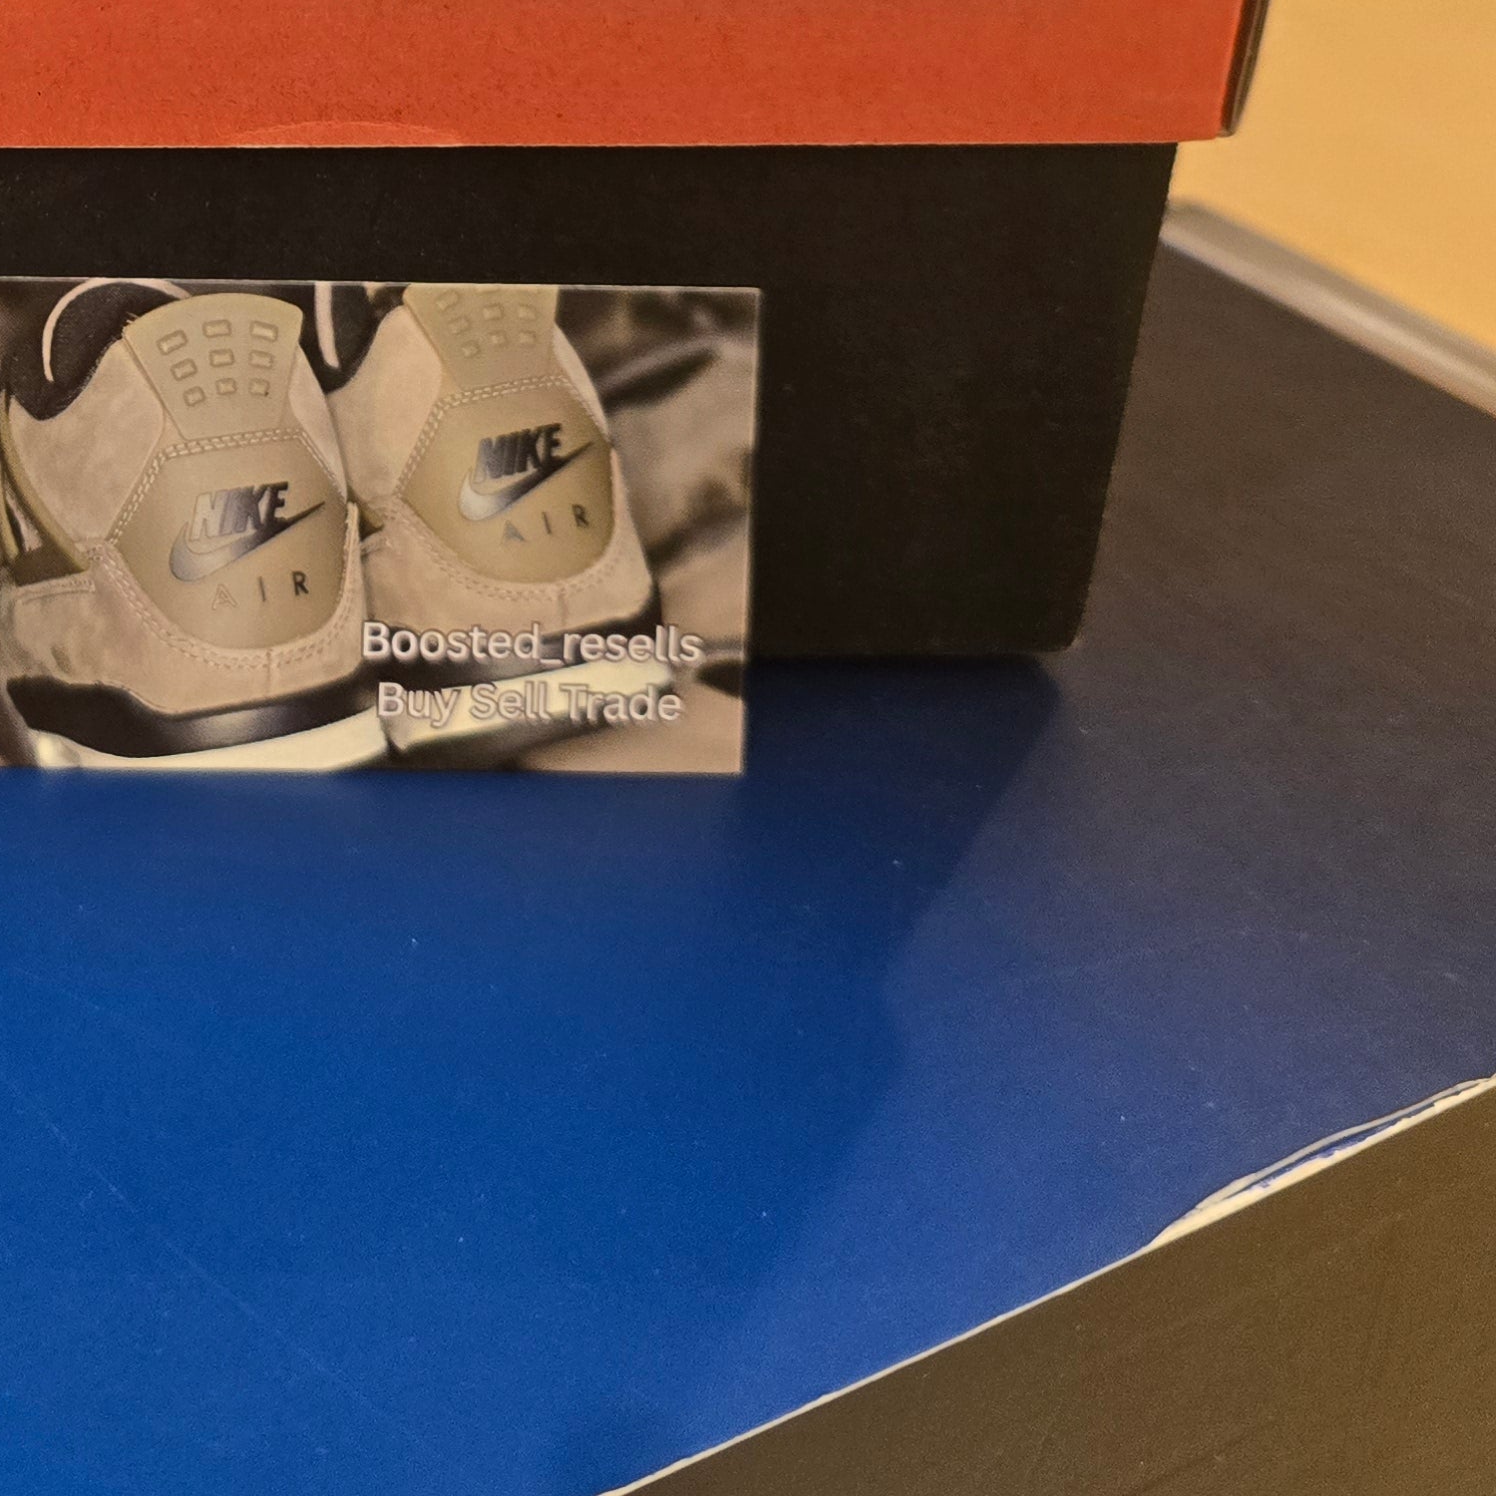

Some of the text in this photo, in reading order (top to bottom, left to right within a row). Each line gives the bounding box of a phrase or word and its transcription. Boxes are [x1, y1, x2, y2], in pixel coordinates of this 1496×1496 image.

[475, 423, 562, 485] NIKE
[189, 481, 289, 542] NIKE
[501, 503, 590, 546] AIR
[211, 570, 310, 611] AIR
[362, 621, 704, 665] Boosted_resells
[377, 681, 685, 727] Buy Sell Trade
